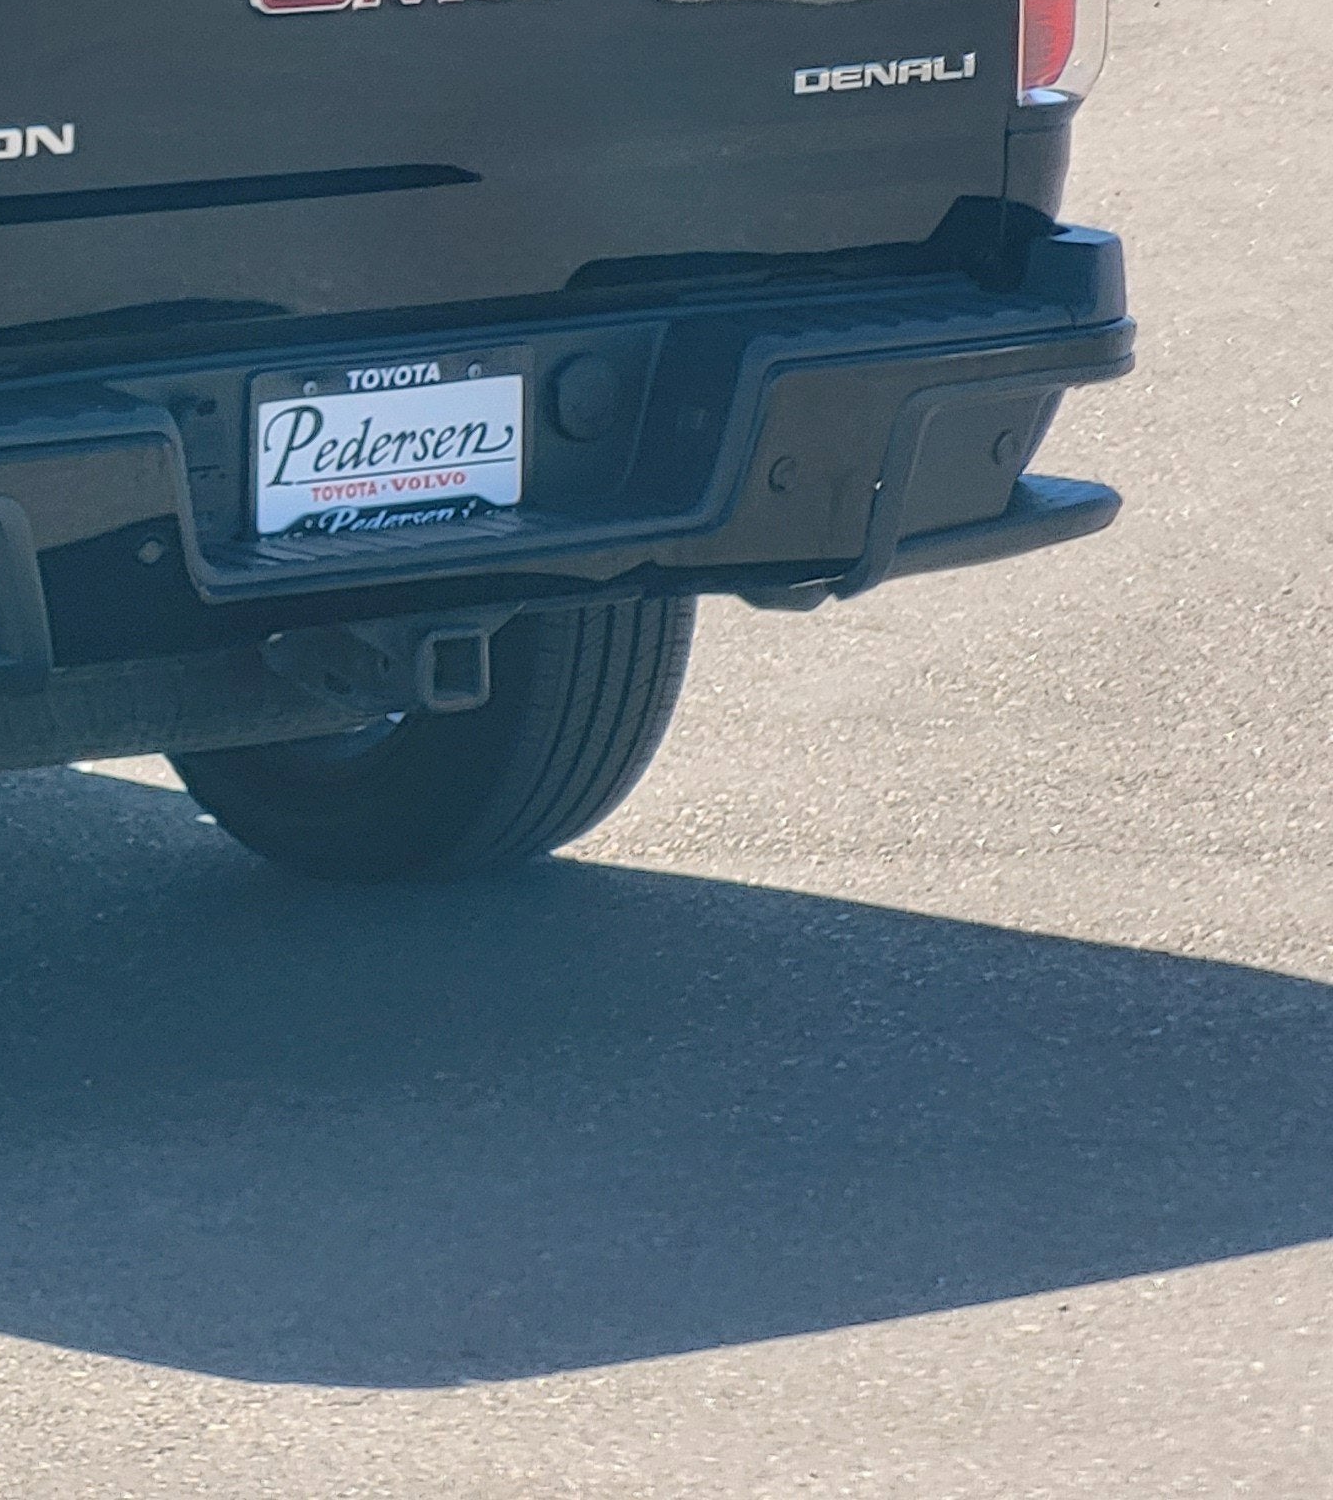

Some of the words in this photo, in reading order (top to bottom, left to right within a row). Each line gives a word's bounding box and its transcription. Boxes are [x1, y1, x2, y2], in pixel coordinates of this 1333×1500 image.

[794, 52, 976, 95] DENALI
[346, 362, 441, 391] TOYOTA
[263, 405, 514, 487] Pedersen
[311, 485, 378, 502] TOYOTA
[391, 471, 467, 493] VOLVO
